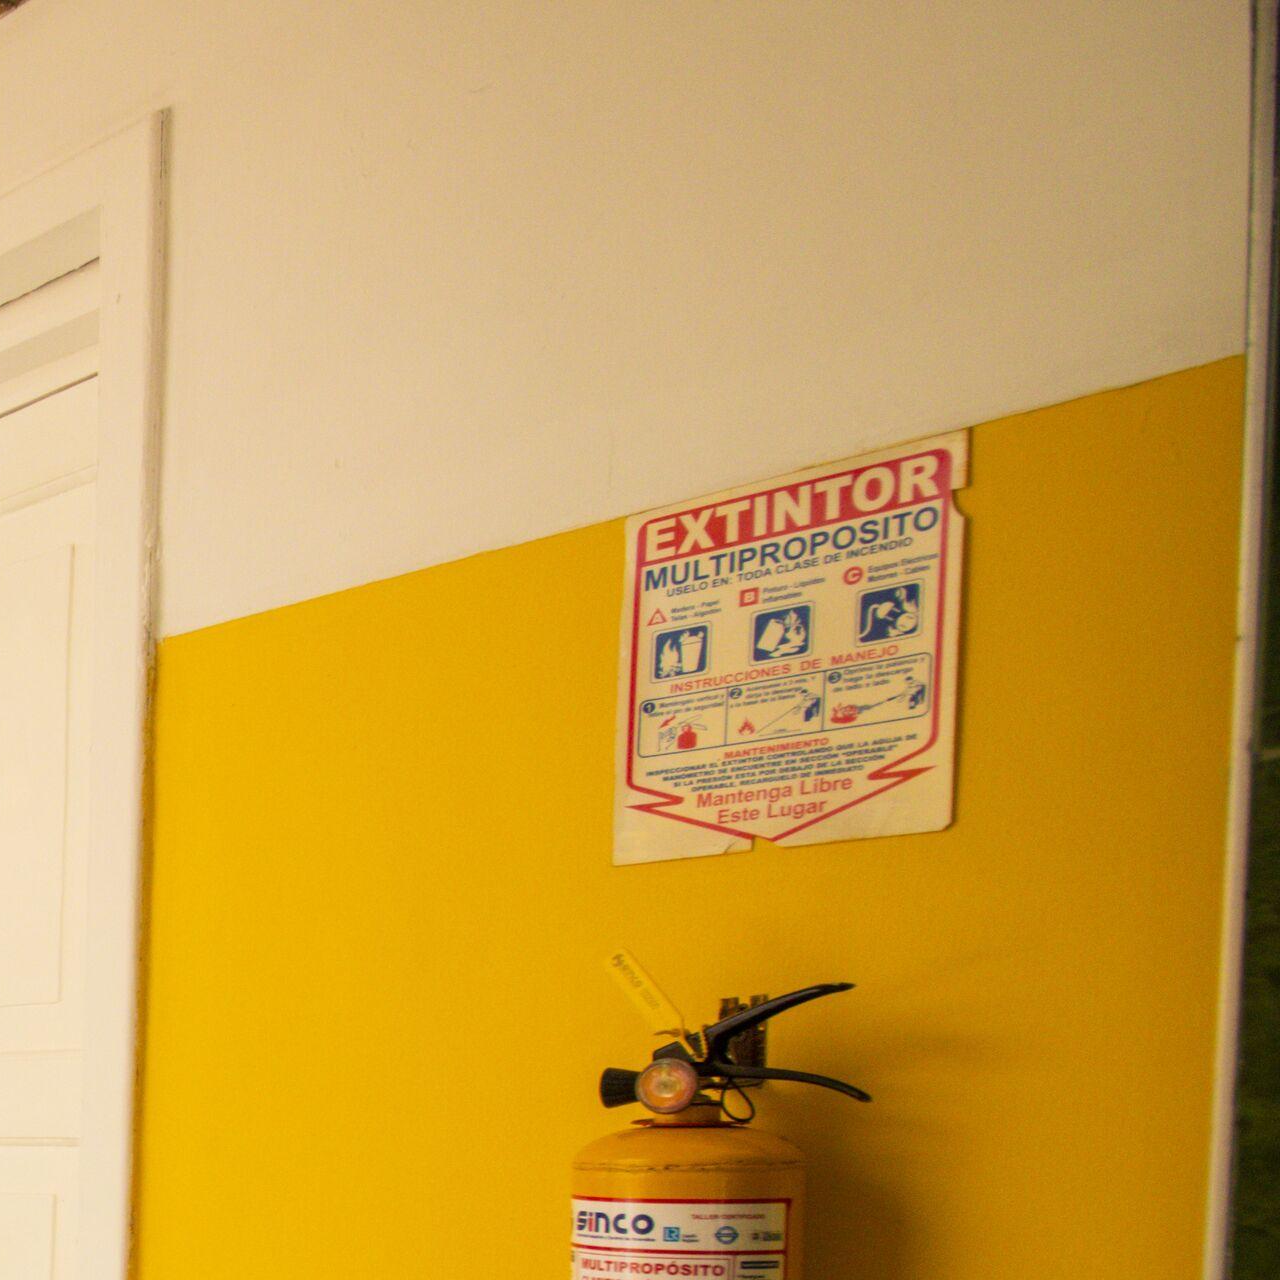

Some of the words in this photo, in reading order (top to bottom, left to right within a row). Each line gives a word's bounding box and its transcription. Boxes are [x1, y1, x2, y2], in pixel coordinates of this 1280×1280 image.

[645, 455, 939, 562] EXTINTOR
[645, 506, 939, 591] MULTIPROPOSITO
[666, 581, 709, 597] USELO
[737, 568, 772, 581] TODA
[776, 558, 819, 574] CLASE
[824, 552, 841, 564] DE
[846, 537, 914, 558] INCENDIO
[670, 663, 791, 694] INSTRUCCIONES
[800, 658, 822, 671] DE
[831, 645, 900, 665] MANEJO
[723, 737, 830, 759] MANTENIMIENTO
[696, 785, 793, 808] Mantenga
[800, 777, 853, 795] Libre
[718, 807, 760, 824] Este
[767, 800, 827, 819] Lugar
[581, 1257, 726, 1277] MULTIPROPÓSITO
